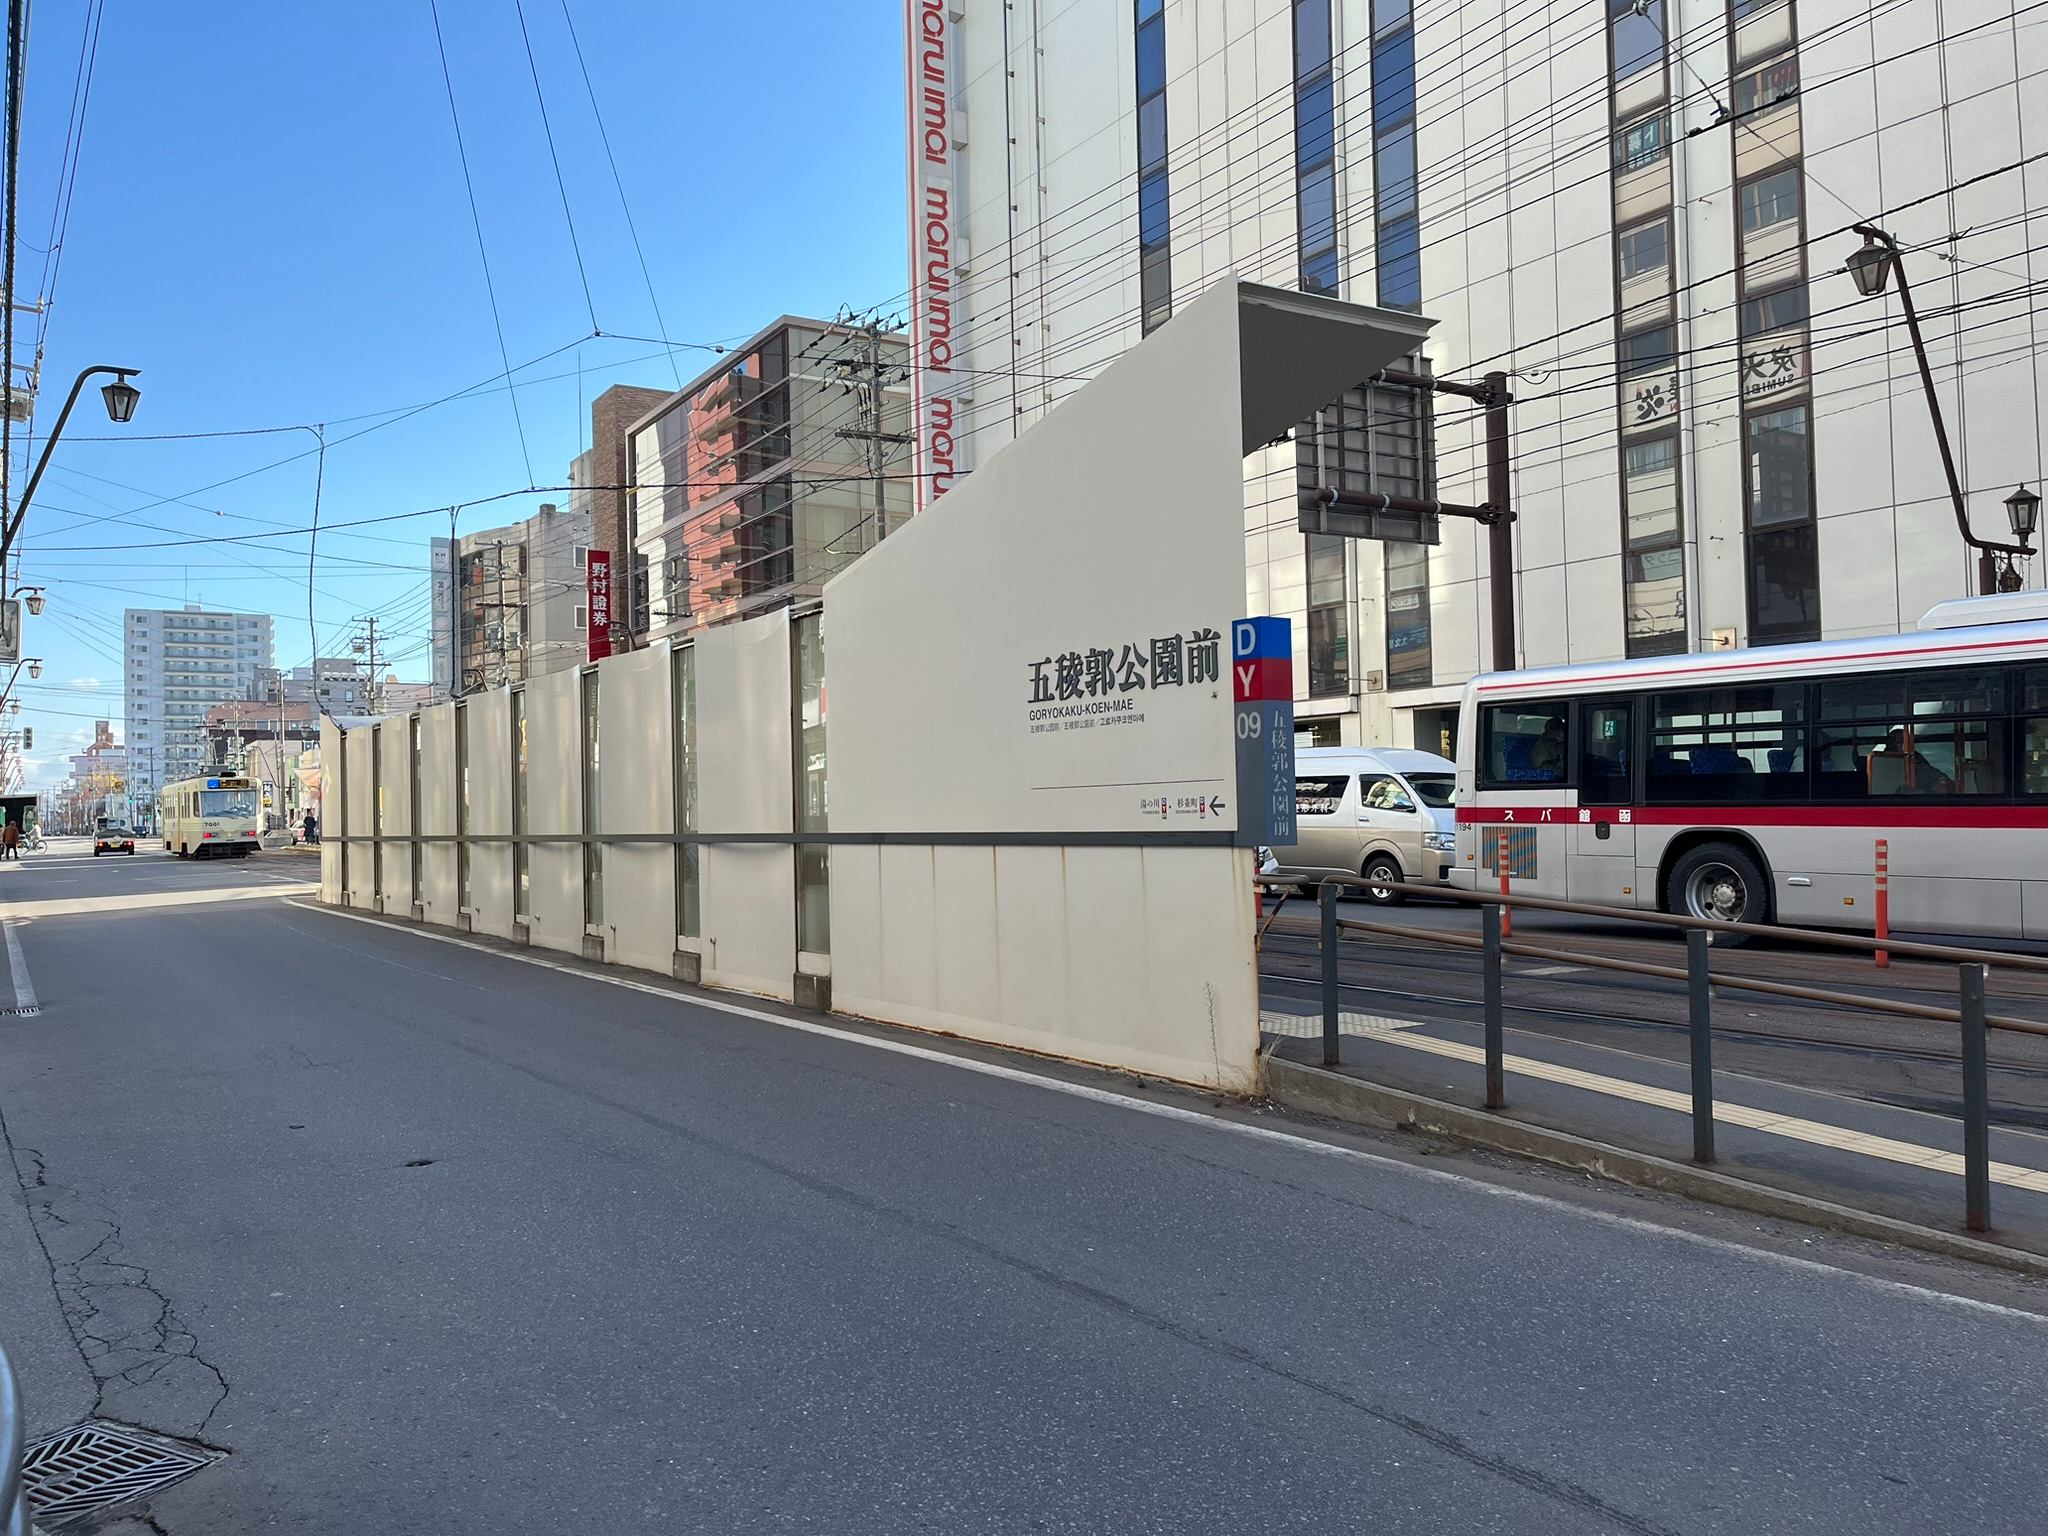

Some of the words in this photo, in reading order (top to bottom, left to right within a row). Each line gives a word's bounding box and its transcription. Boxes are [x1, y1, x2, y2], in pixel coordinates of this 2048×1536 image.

[931, 397, 954, 501] maru
[592, 562, 608, 627] 野村證券
[1027, 628, 1221, 704] 五稜郭公園前
[1029, 698, 1134, 721] GORYOKAKU-KOEN-MAE
[1237, 711, 1261, 740] 09
[1271, 708, 1290, 836] 五稜郭公園前
